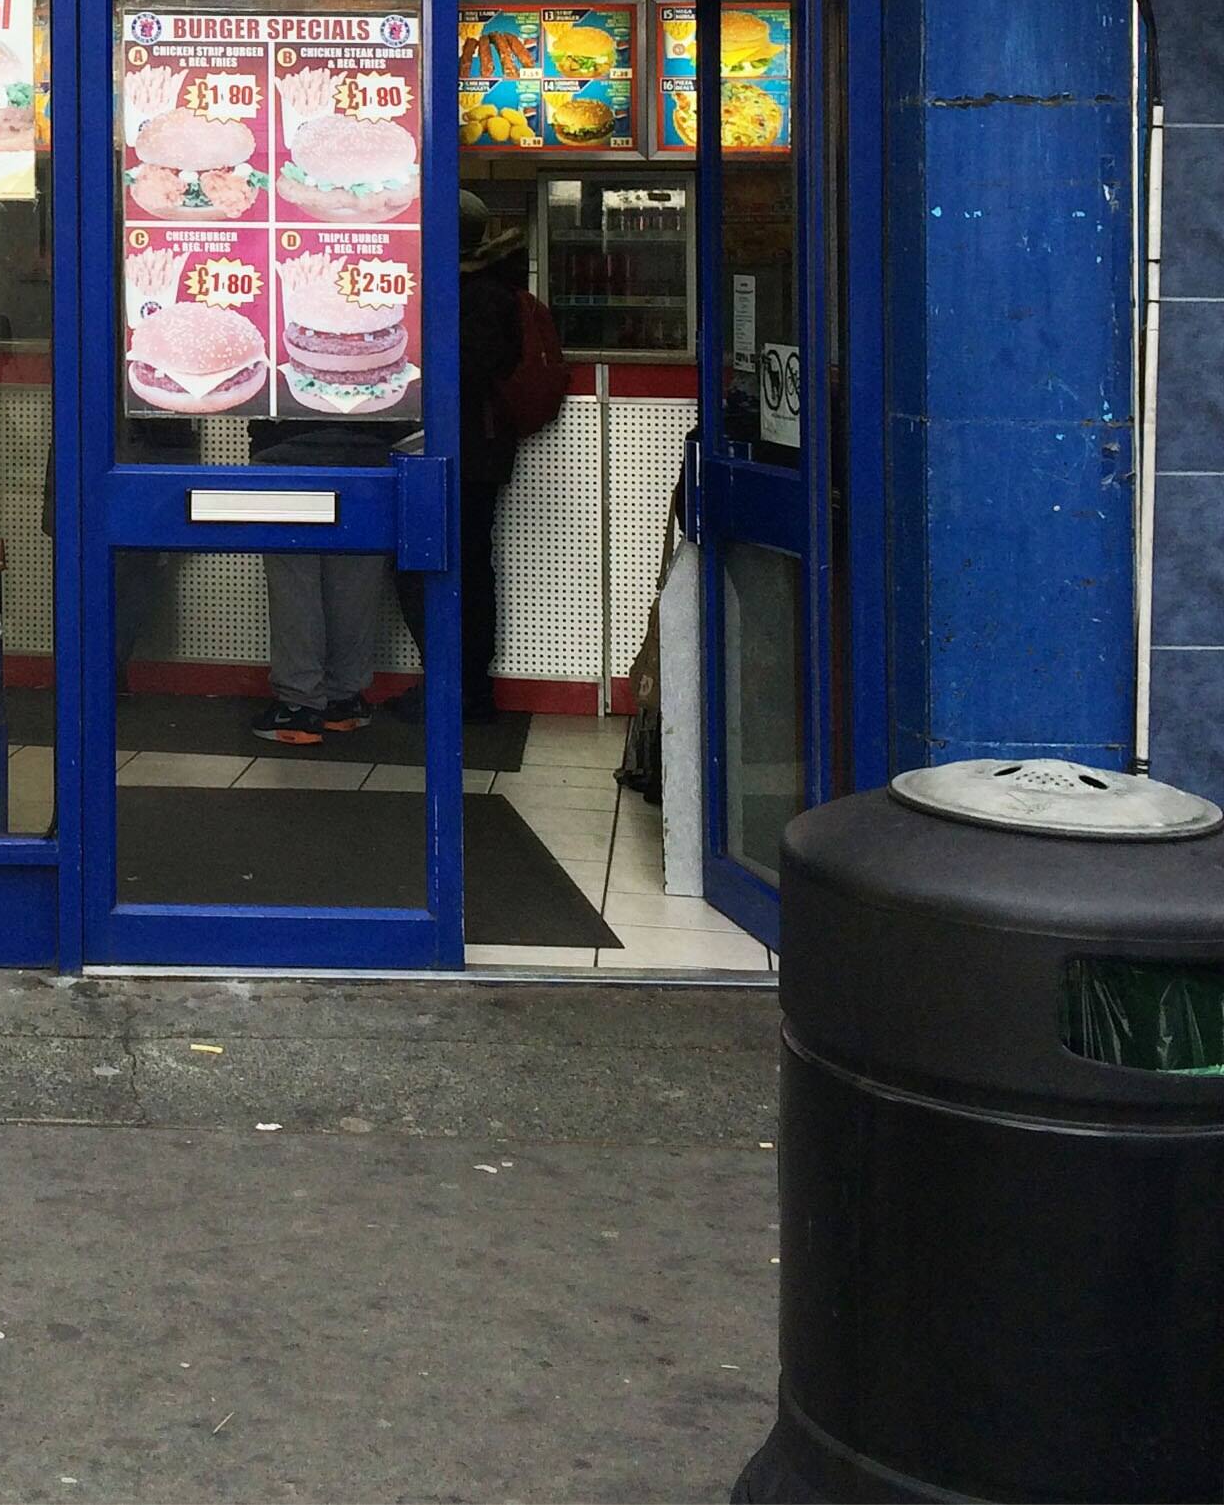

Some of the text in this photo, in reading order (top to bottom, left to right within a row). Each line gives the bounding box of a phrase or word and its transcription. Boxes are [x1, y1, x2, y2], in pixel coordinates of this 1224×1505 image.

[544, 11, 554, 21] 13
[663, 9, 674, 19] 15
[173, 18, 260, 40] BURGER
[267, 18, 371, 41] SPECIALS
[134, 49, 143, 62] A
[153, 46, 194, 57] CHICKEN
[196, 46, 224, 57] STRIP
[300, 47, 413, 59] CHICKEN STEAK BURGER
[211, 57, 238, 68] FRIES
[283, 51, 293, 64] B
[360, 59, 386, 69] FRIES
[544, 81, 554, 91] 14
[663, 80, 674, 91] 16
[135, 232, 145, 245] C
[287, 234, 297, 247] D
[318, 233, 390, 244] TRIPLE BURGER
[205, 243, 231, 253] FRIES
[357, 245, 384, 255] FRIES
